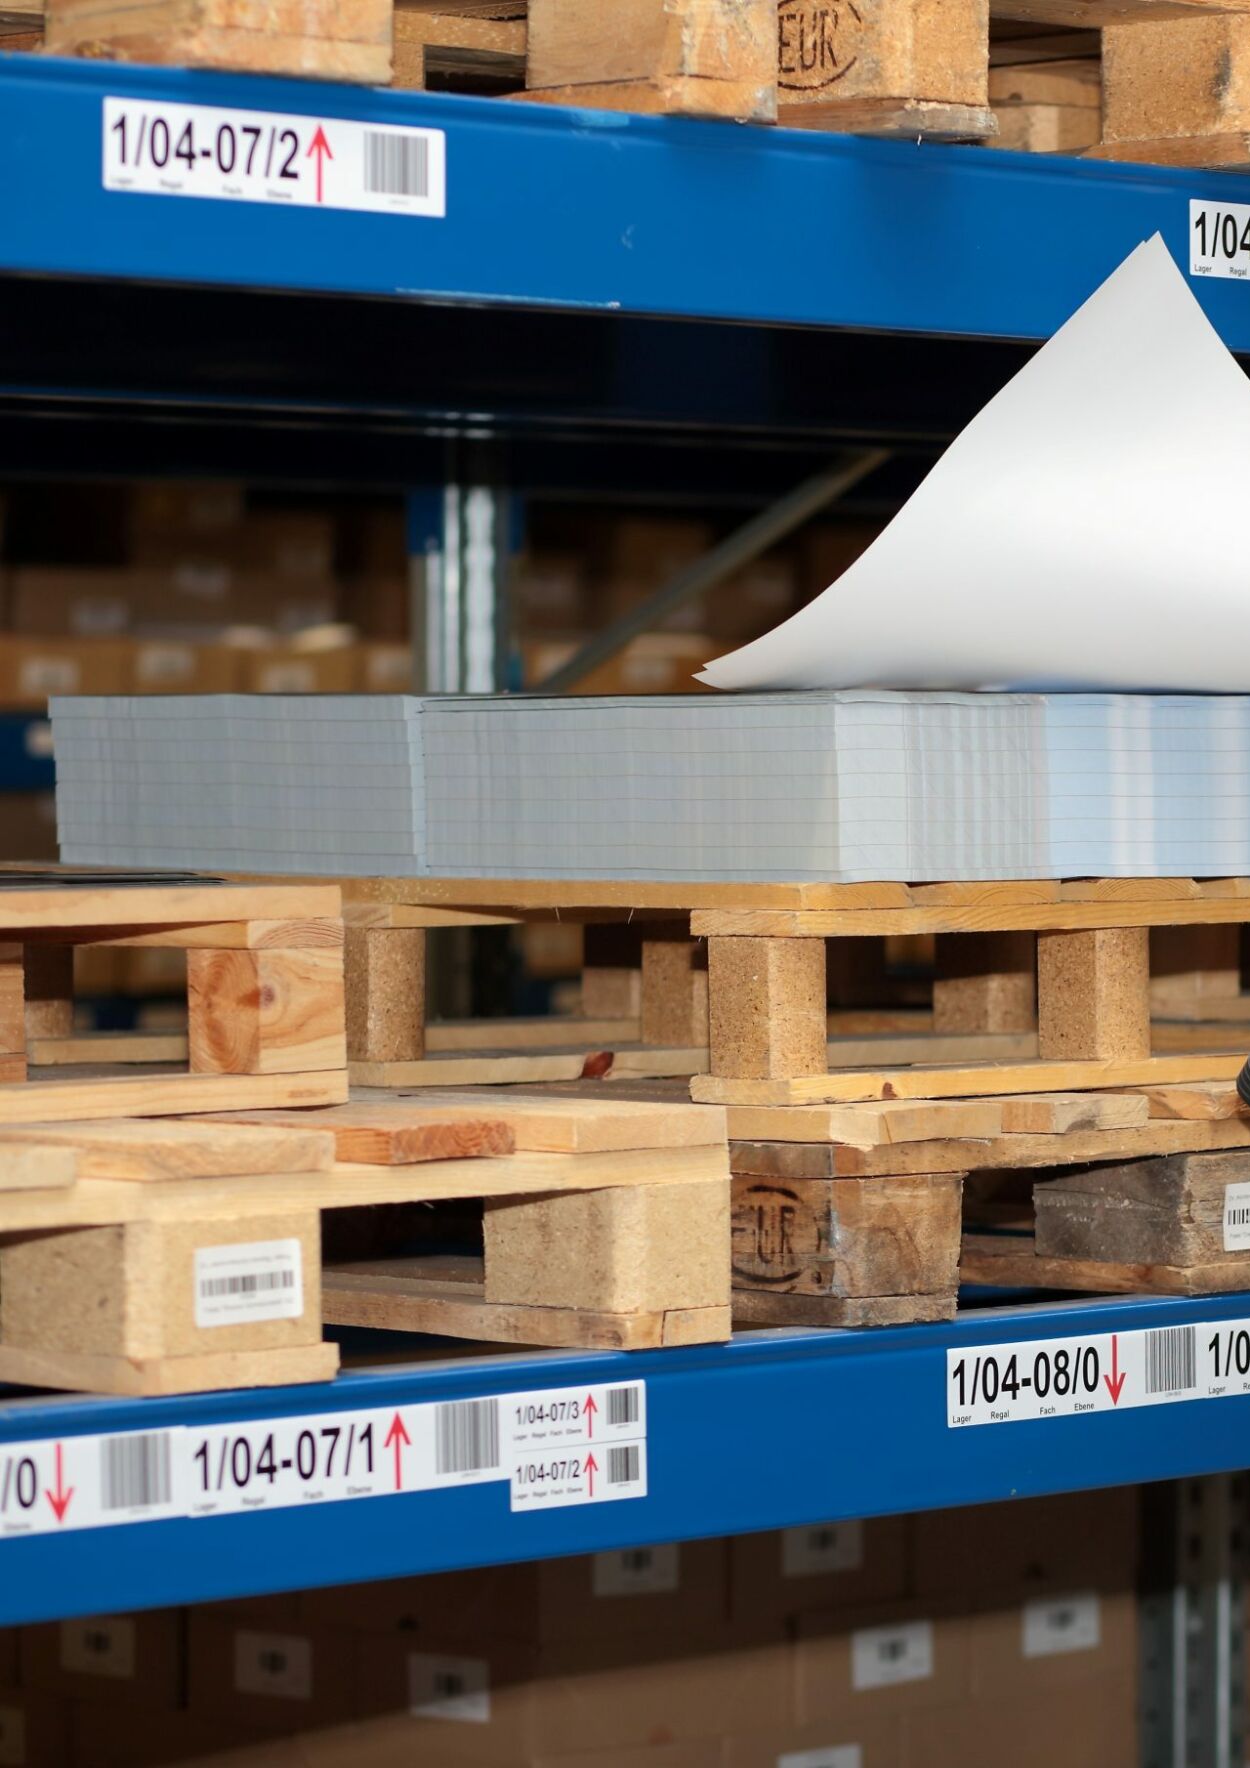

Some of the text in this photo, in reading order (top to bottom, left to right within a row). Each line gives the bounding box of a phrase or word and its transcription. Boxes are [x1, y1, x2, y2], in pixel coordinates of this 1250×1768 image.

[778, 9, 838, 73] EUR
[112, 113, 300, 180] 1/04-07/2
[1194, 264, 1212, 274] Lager
[1229, 267, 1248, 277] Regal
[953, 1346, 1100, 1405] 1/04-08/0
[1208, 1385, 1226, 1395] Lager
[515, 1400, 580, 1426] 1/04-07/3
[952, 1402, 1095, 1424] Lager Regal Fach Ebene
[194, 1422, 373, 1491] 1/04-07/1
[516, 1459, 581, 1485] 1/04-07/2
